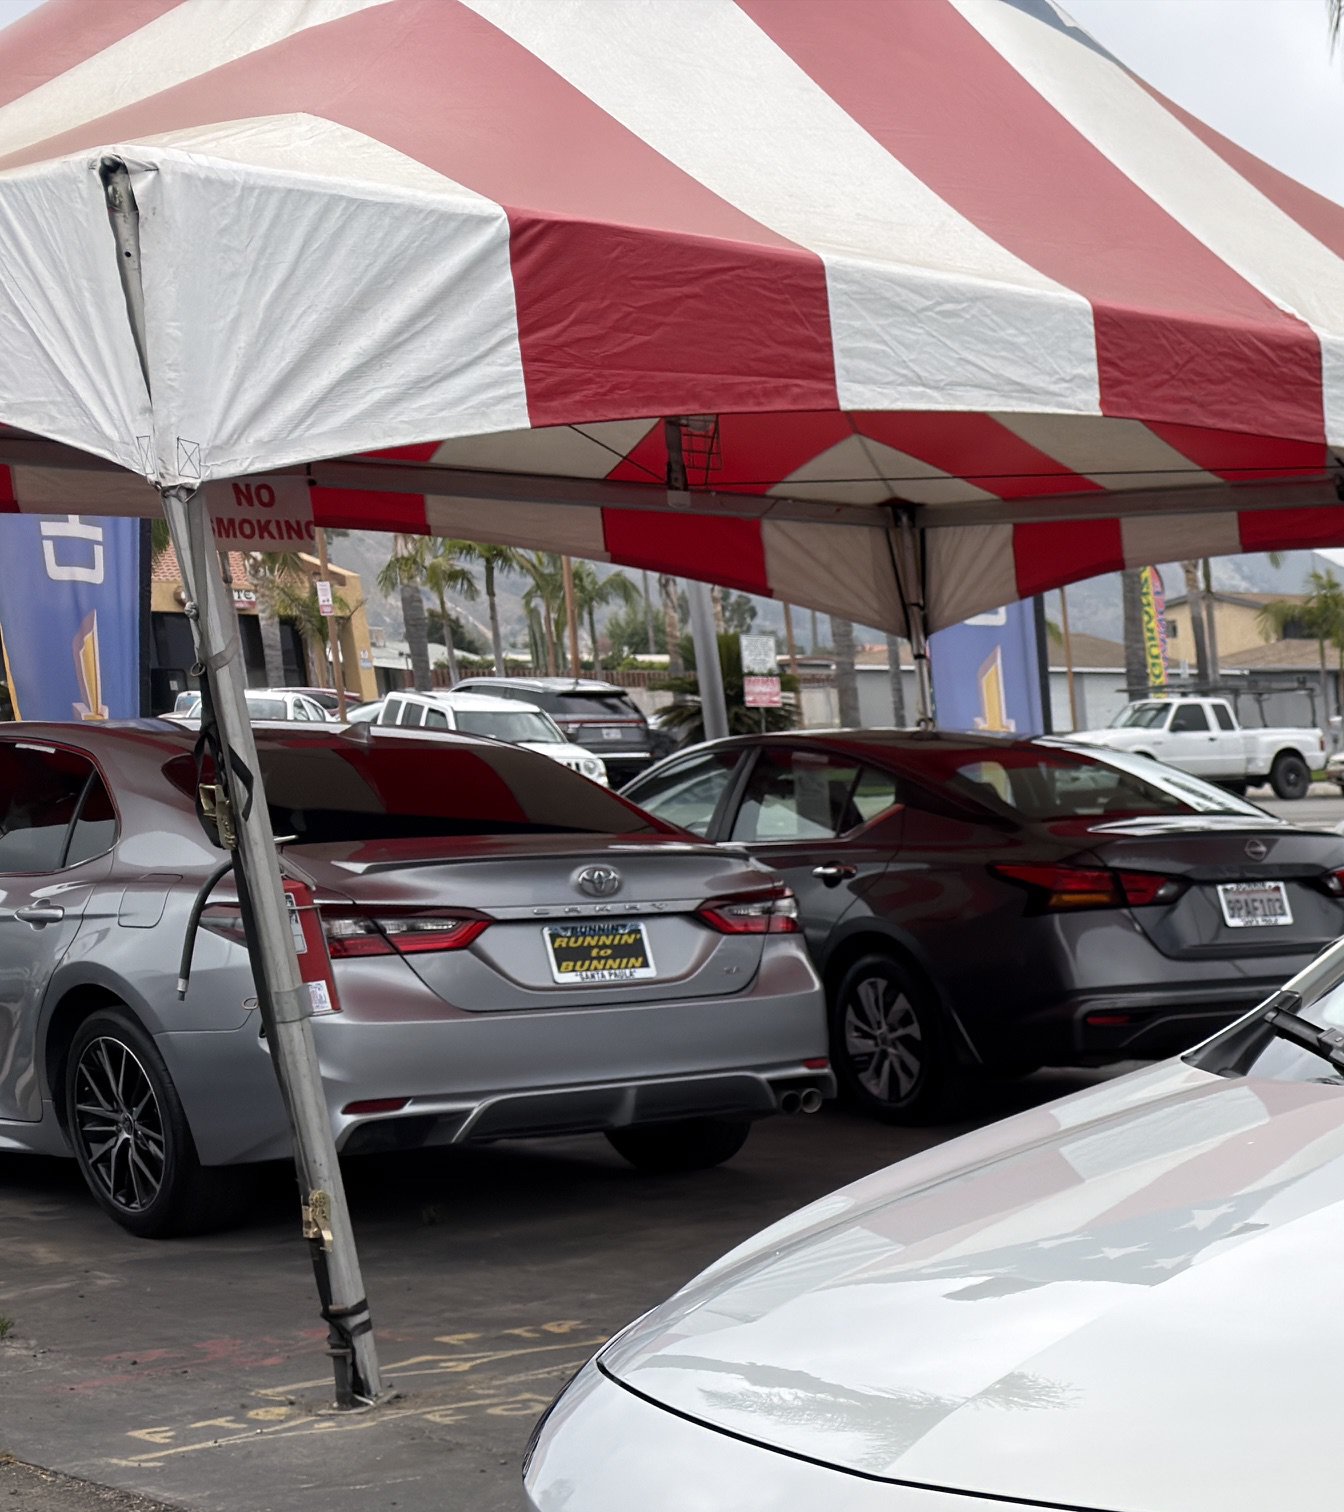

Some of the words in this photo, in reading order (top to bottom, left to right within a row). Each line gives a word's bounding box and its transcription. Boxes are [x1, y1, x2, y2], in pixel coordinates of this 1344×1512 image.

[231, 482, 277, 508] NO
[591, 948, 613, 957] to
[560, 956, 643, 972] BUNNIN
